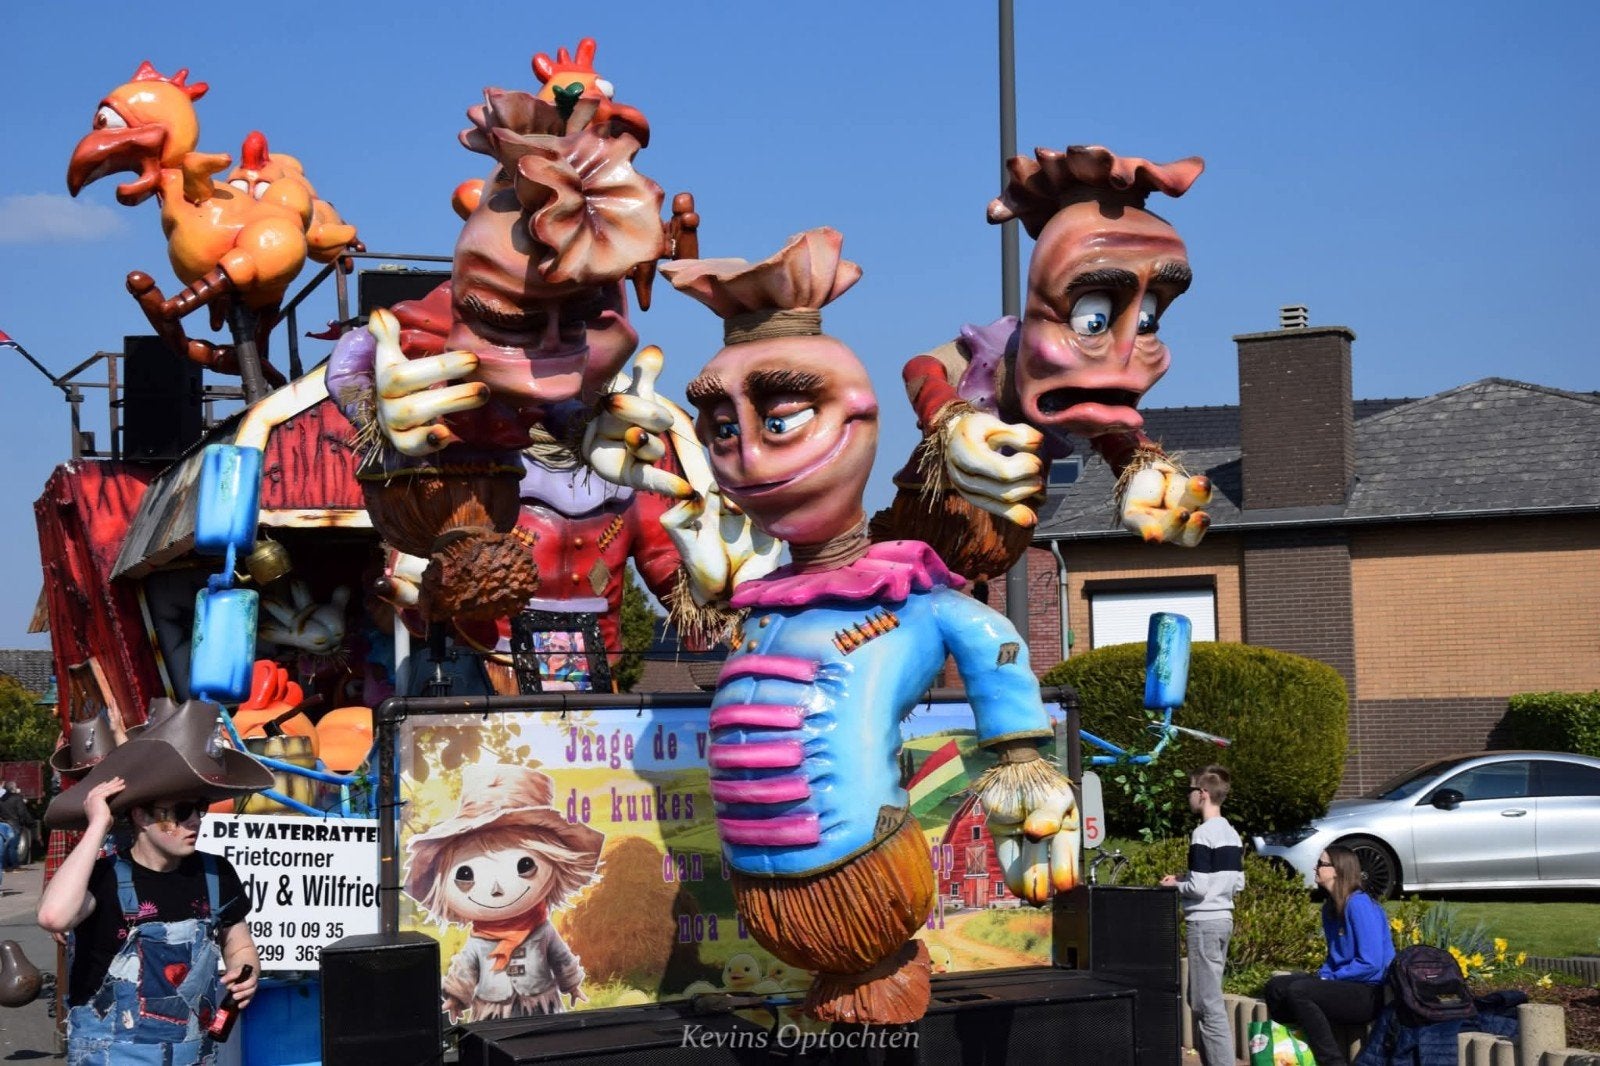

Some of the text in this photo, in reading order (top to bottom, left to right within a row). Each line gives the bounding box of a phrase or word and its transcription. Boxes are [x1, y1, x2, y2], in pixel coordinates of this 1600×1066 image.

[565, 726, 635, 770] Jaage
[653, 724, 678, 760] de
[566, 786, 695, 824] de kuukes
[213, 821, 380, 843] DE WATERRATTE
[1085, 817, 1099, 840] 5
[224, 845, 334, 868] Frietcorner
[662, 846, 704, 882] dan
[276, 874, 293, 907] &
[278, 921, 297, 938] 10
[301, 922, 320, 938] 09
[325, 922, 344, 939] 35
[678, 912, 719, 943] noa
